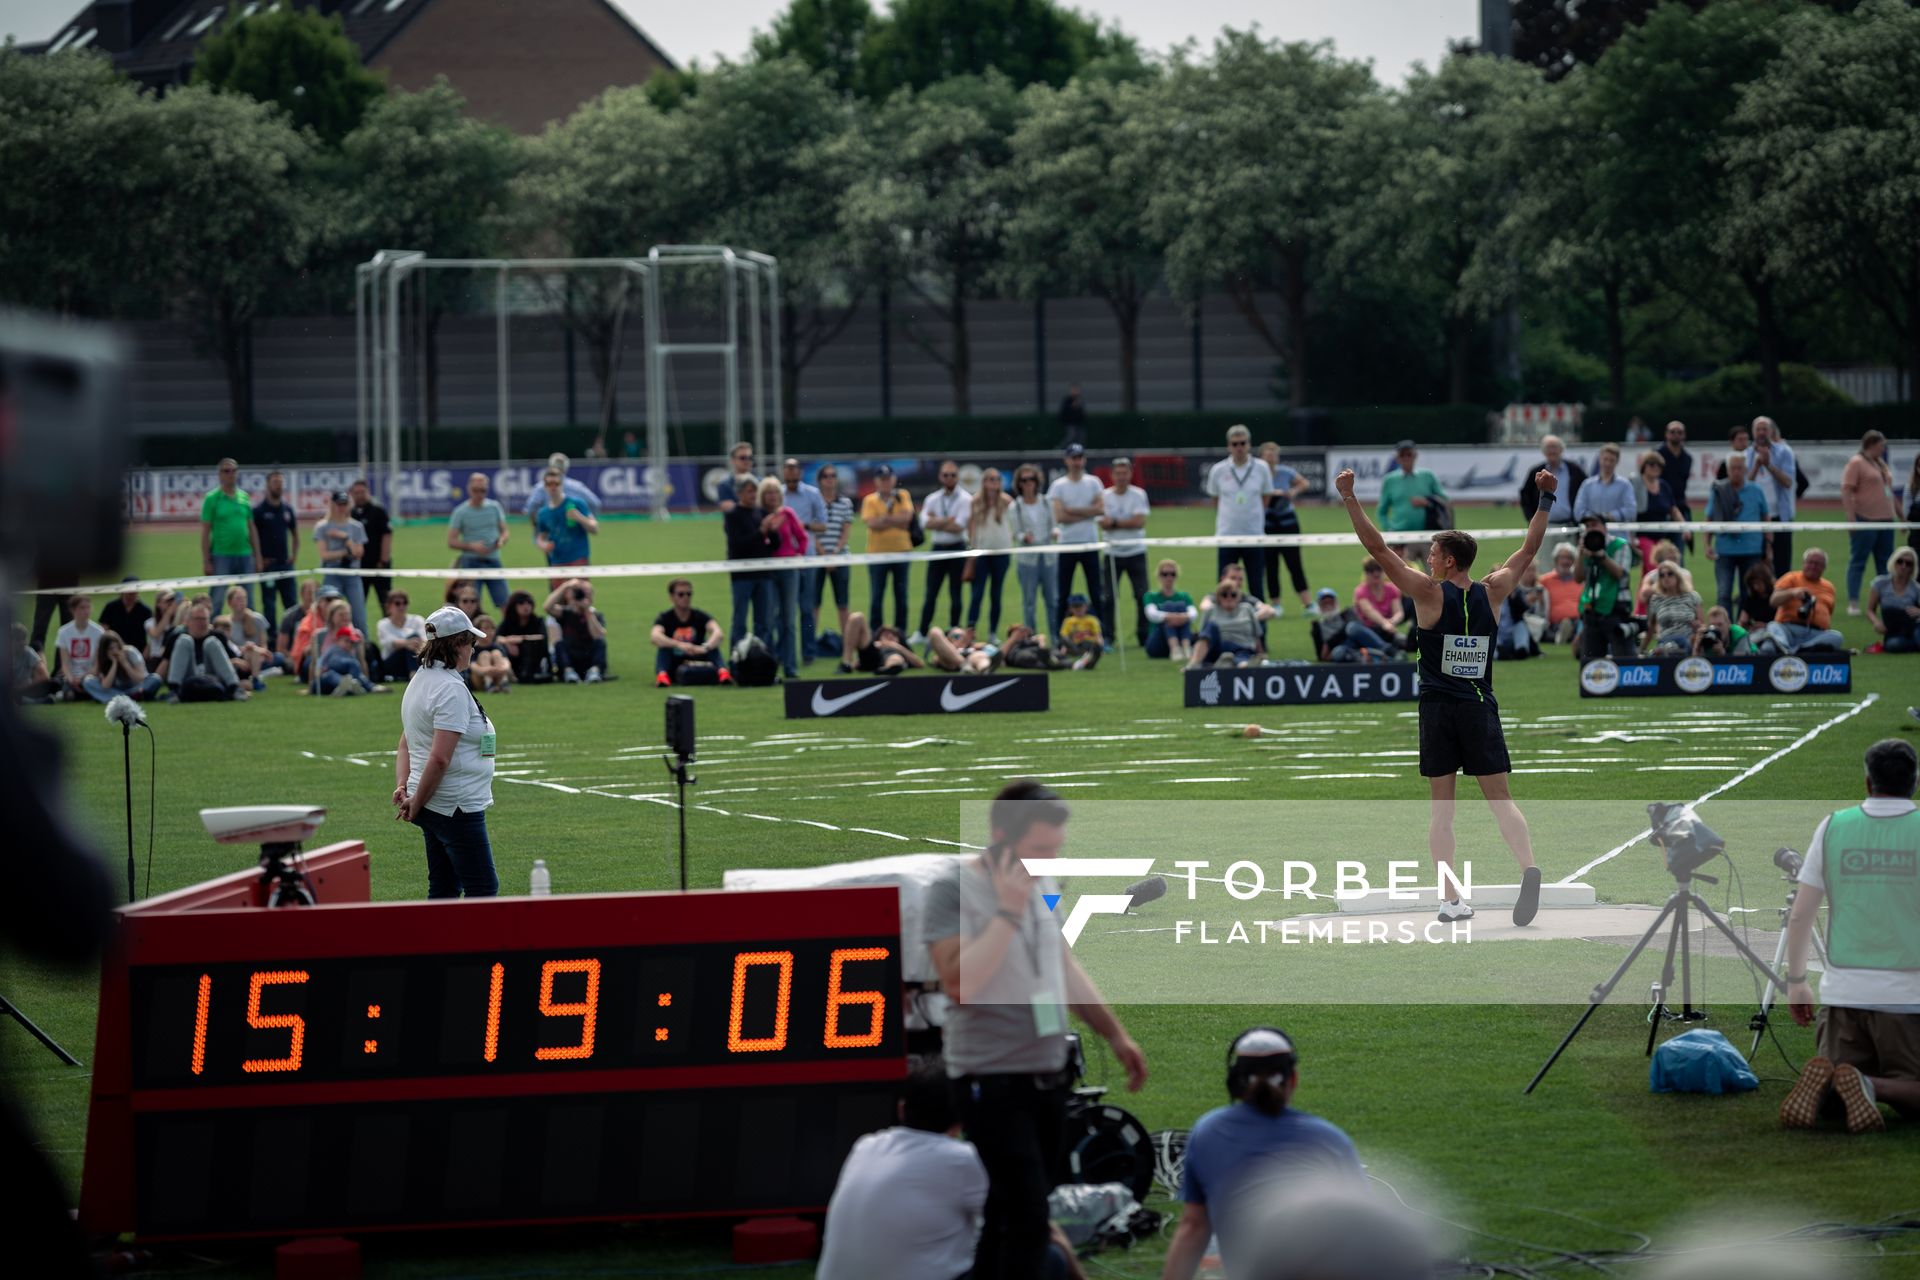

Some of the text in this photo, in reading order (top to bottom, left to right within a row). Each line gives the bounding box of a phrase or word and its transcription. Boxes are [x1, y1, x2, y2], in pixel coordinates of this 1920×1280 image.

[385, 469, 452, 499] GLS
[600, 467, 665, 497] GLS
[1454, 637, 1478, 648] GLS
[1445, 650, 1487, 663] EHAMMER
[1870, 851, 1913, 867] PLAN
